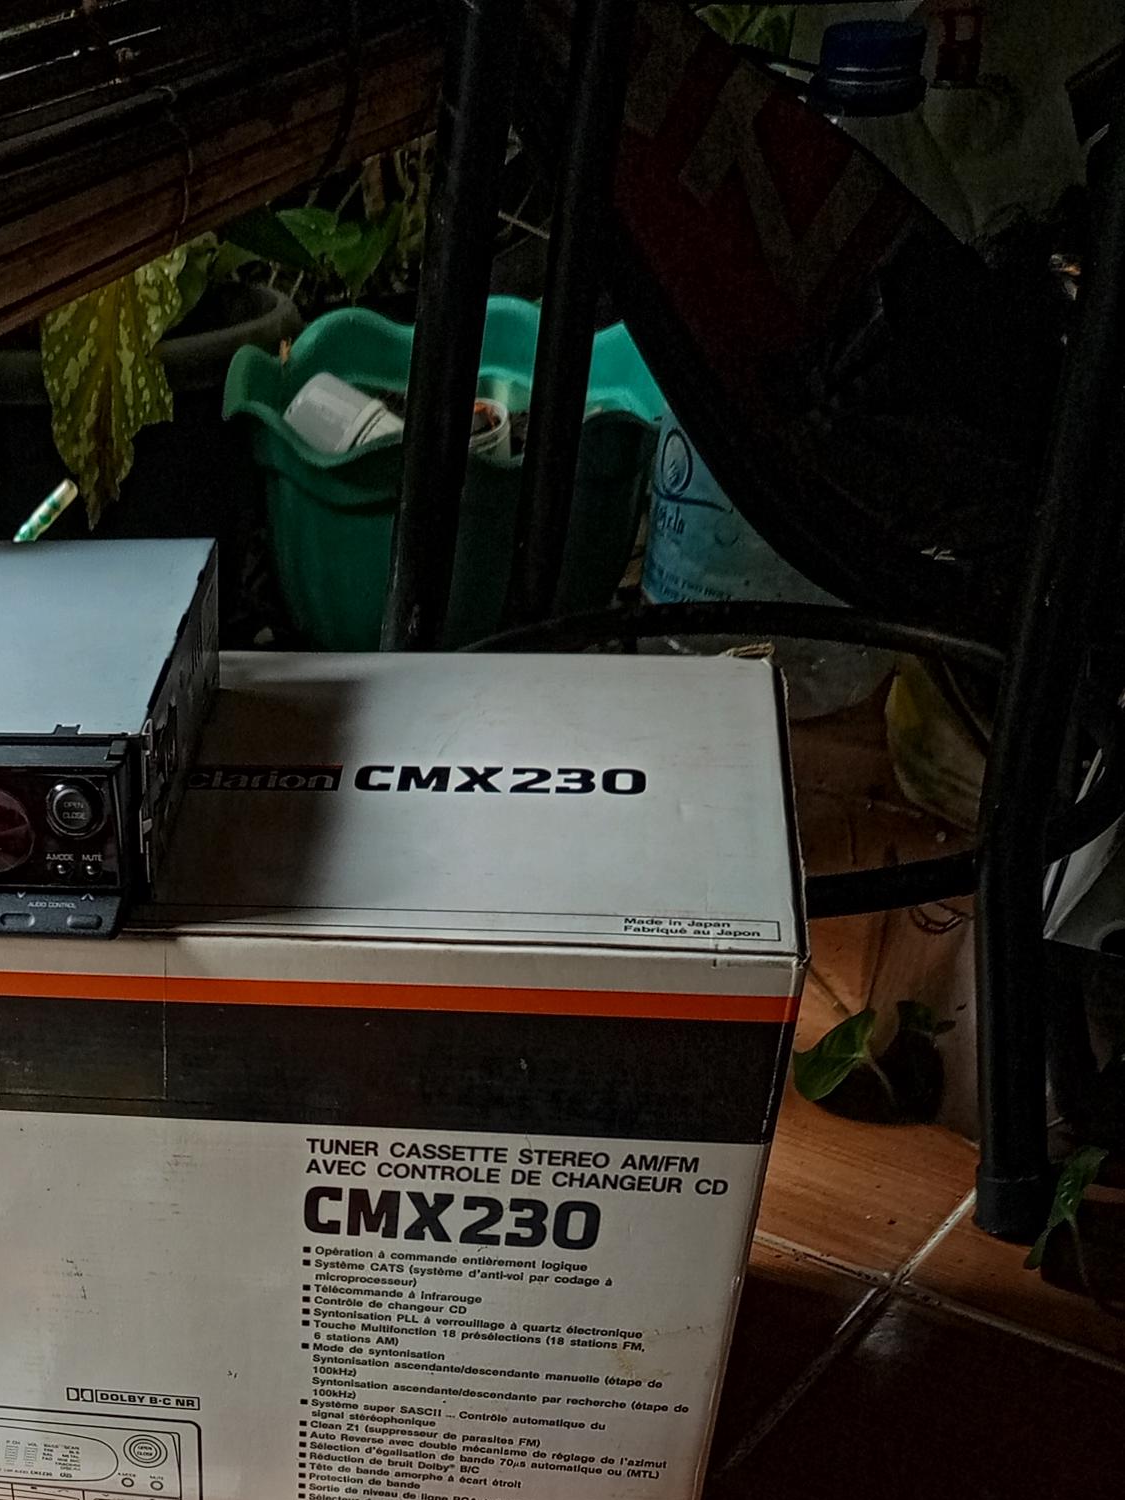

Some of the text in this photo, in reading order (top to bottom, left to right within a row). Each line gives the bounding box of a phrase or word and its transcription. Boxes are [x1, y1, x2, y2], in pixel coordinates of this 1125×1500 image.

[186, 765, 647, 796] clarion CMX230
[62, 811, 87, 820] CLOSE
[82, 854, 103, 862] MUTE
[623, 925, 688, 935] Fabriqué
[716, 929, 761, 938] Japon
[624, 917, 732, 930] Made in Japan
[305, 1137, 700, 1174] TUNER CASSETTE STEREO AM/FM
[305, 1158, 729, 1196] AVEC CONTROLE DE CHANGEUR CD
[303, 1185, 602, 1251] CMX230
[314, 1245, 588, 1273] Opération à commande entièrement logique
[314, 1258, 613, 1288] Système CATS (système d'anti-vol par codage à
[314, 1271, 418, 1288] microprocesseur)
[313, 1283, 483, 1305] Télécommande à infrarouge
[313, 1295, 468, 1315] Contrôle de changeur CD
[313, 1307, 645, 1340] Syntonisation PLL à verrouillage à quartz électronique
[312, 1342, 446, 1361] Mode de syntonisation
[100, 1392, 146, 1404] DOLBY
[175, 1398, 195, 1408] NR
[309, 1419, 541, 1448] Clean Z1 (suppresseur de parasites FM)
[309, 1430, 668, 1469] Auto Reverse avec double mécanisme de réglage de l'azimut
[308, 1472, 421, 1490] Protection de bande
